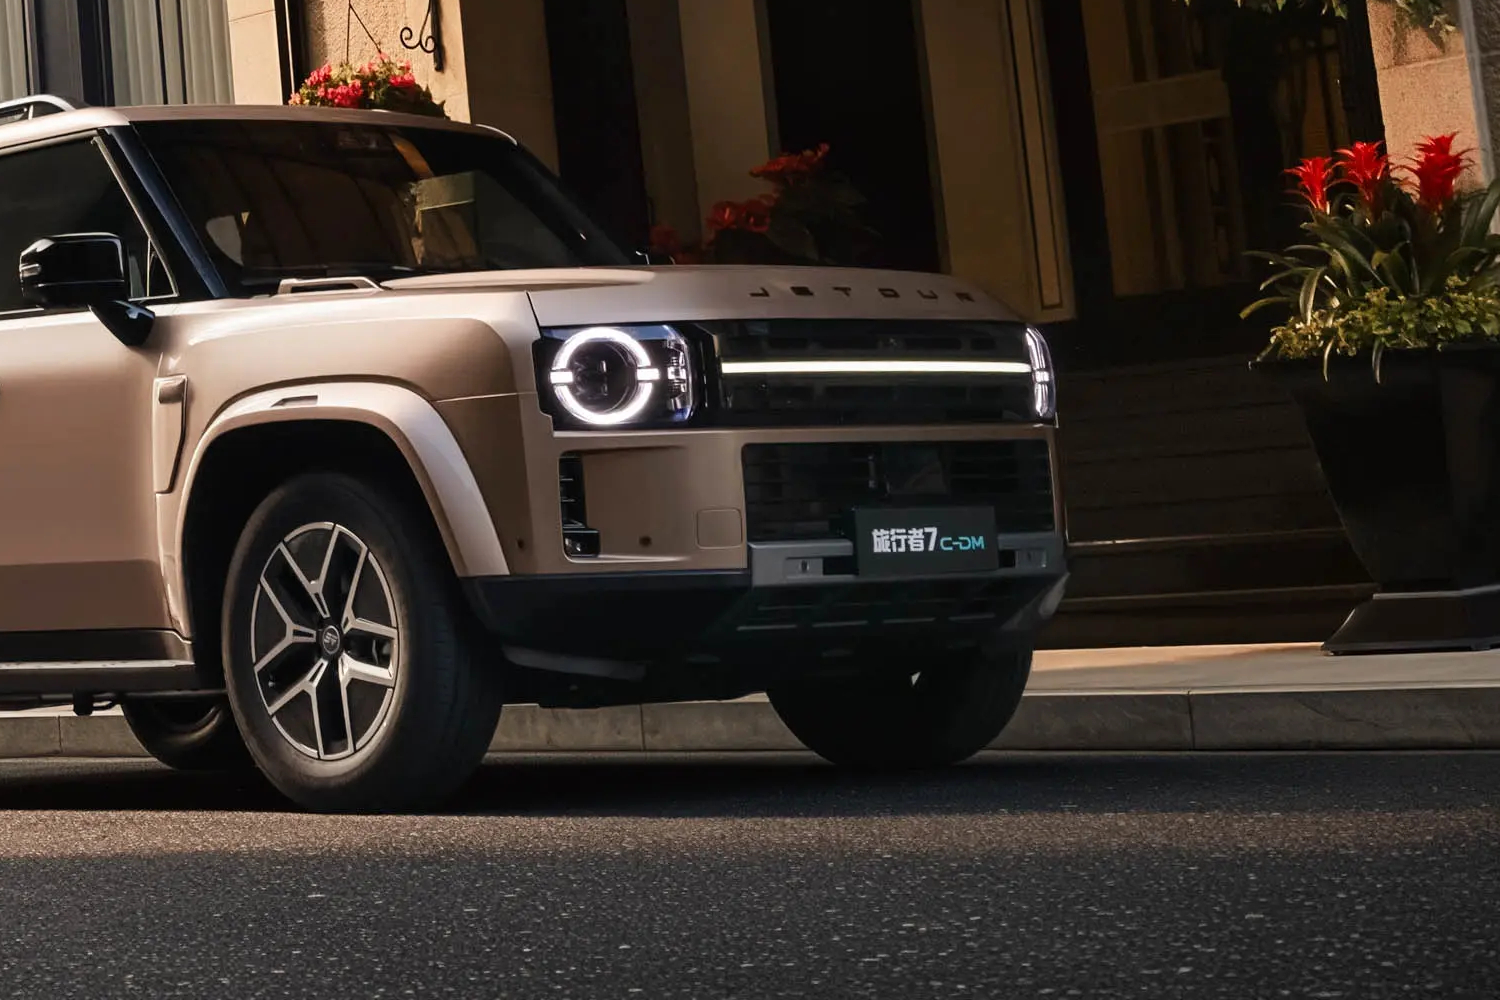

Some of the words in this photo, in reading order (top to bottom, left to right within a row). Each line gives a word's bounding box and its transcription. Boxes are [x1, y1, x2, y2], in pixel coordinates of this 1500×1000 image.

[749, 285, 974, 303] JETOUR
[871, 527, 938, 553] 旅行者7
[940, 535, 985, 551] C-DM
